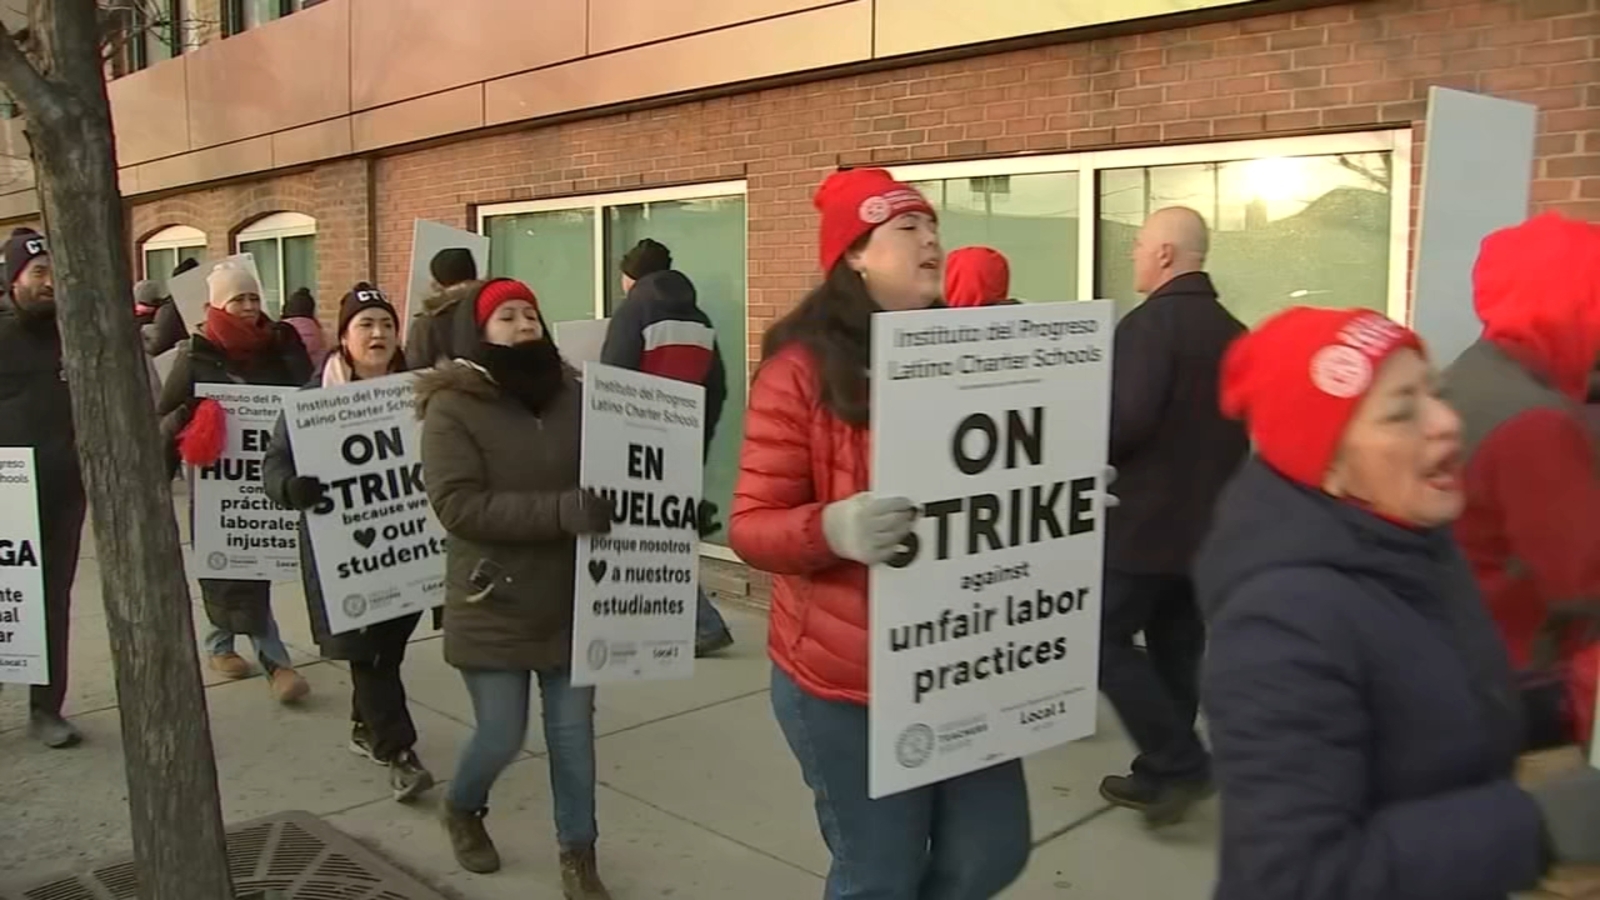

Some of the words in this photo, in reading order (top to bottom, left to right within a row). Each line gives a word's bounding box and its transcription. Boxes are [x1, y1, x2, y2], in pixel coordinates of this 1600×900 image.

[357, 290, 388, 303] CT
[893, 325, 980, 348] Instituto
[987, 320, 1016, 341] del
[1019, 318, 1099, 341] Progreso
[888, 358, 953, 380] Latino
[958, 352, 1030, 375] Charter
[1032, 344, 1102, 368] Schools
[253, 394, 269, 404] del
[296, 395, 350, 412] Instituto
[352, 391, 372, 405] del
[594, 376, 638, 399] Instituto
[639, 386, 655, 401] del
[656, 389, 698, 410] Progreso
[238, 405, 277, 417] Charter
[296, 411, 337, 429] Latino
[338, 404, 384, 422] Charter
[591, 395, 623, 414] Latino
[624, 402, 662, 421] Charter
[663, 410, 700, 429] Schools
[341, 426, 404, 466] ON
[952, 406, 1044, 476] ON
[628, 442, 664, 482] EN
[221, 496, 300, 513] práctic
[342, 502, 405, 526] because
[588, 486, 698, 532] UELGA
[220, 514, 300, 531] laborales
[382, 515, 427, 542] our
[227, 532, 297, 551] injustas
[590, 536, 637, 555] porque
[639, 538, 691, 555] nosotros
[337, 536, 448, 580] students
[611, 566, 621, 583] a
[625, 564, 691, 584] nuestros
[960, 560, 1031, 592] against
[592, 593, 684, 616] estudiantes
[889, 602, 998, 652] unfair
[1006, 586, 1089, 627] labor
[913, 635, 1067, 704] practices
[1019, 704, 1056, 725] Local
[1058, 700, 1067, 714] 1
